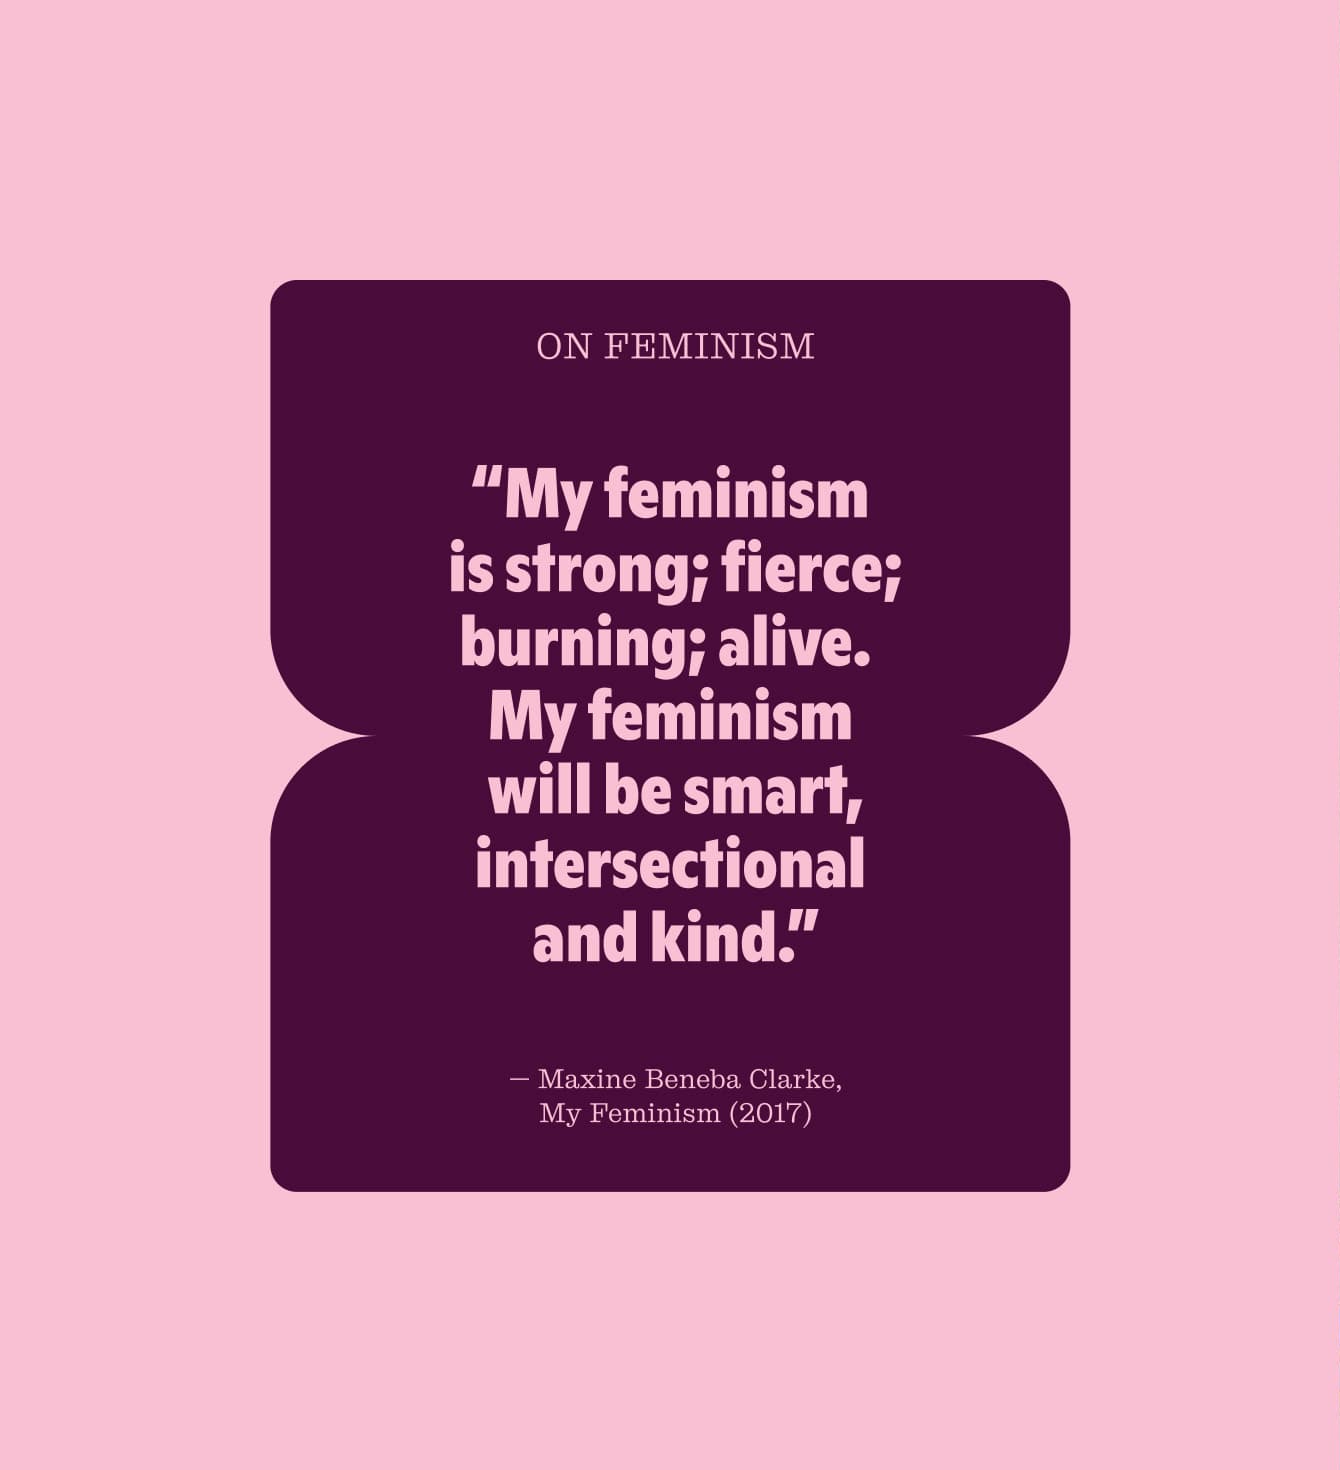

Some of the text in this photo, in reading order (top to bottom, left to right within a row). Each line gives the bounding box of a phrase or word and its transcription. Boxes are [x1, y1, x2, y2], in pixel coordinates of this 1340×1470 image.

[538, 333, 814, 359] ON FEMINISM
[604, 465, 867, 518] feminism
[451, 539, 901, 606] is strong; fierce;
[462, 613, 870, 680] burning; alive.
[490, 687, 851, 753] My feminism
[488, 761, 862, 824] will be smart,
[477, 835, 864, 888] intersectional
[533, 910, 636, 962] and
[538, 1069, 636, 1089] Maxine
[645, 1069, 741, 1089] Beneba
[750, 1069, 841, 1092] Clarke,
[540, 1101, 811, 1128] My Feminism (2017)
